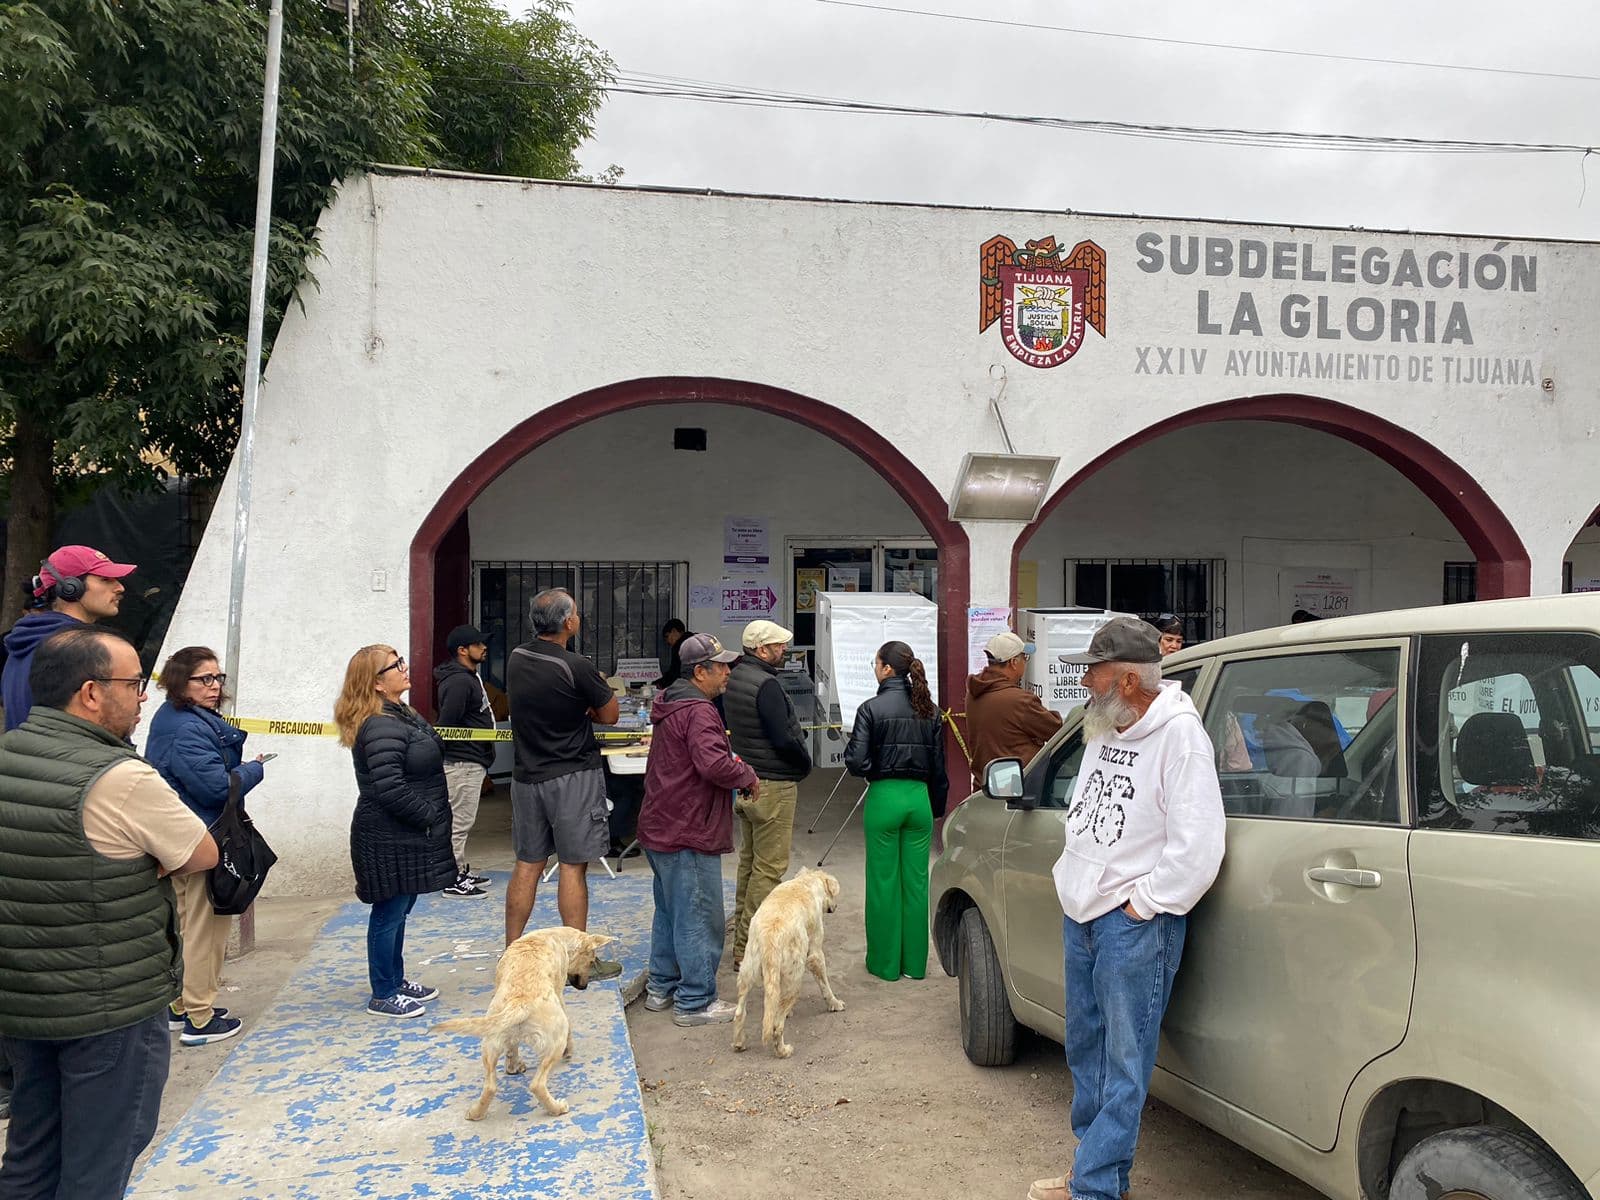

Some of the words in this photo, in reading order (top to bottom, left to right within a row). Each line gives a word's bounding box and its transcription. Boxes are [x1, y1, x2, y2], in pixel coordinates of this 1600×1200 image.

[1136, 232, 1537, 292] SUBDELEGACIÓN
[1015, 273, 1072, 284] TIJUANA
[1003, 298, 1012, 329] AQUI
[1197, 290, 1263, 336] LA
[1280, 294, 1474, 345] GLORIA
[1069, 302, 1083, 348] PATRIA
[1006, 334, 1052, 365] EMPIEZA
[1054, 350, 1071, 362] LA
[1135, 347, 1207, 375] XXIV
[1224, 349, 1400, 381] AYUNTAMIENTO
[1408, 355, 1434, 383] DE
[1442, 356, 1535, 386] TIJUANA
[1323, 595, 1348, 610] 1289
[1049, 665, 1058, 674] EL
[1060, 665, 1080, 674] VOTO
[1056, 676, 1078, 686] LIBRE
[1053, 688, 1088, 699] SECRETO
[1502, 698, 1515, 713] EL
[269, 721, 323, 735] PRECAUCION
